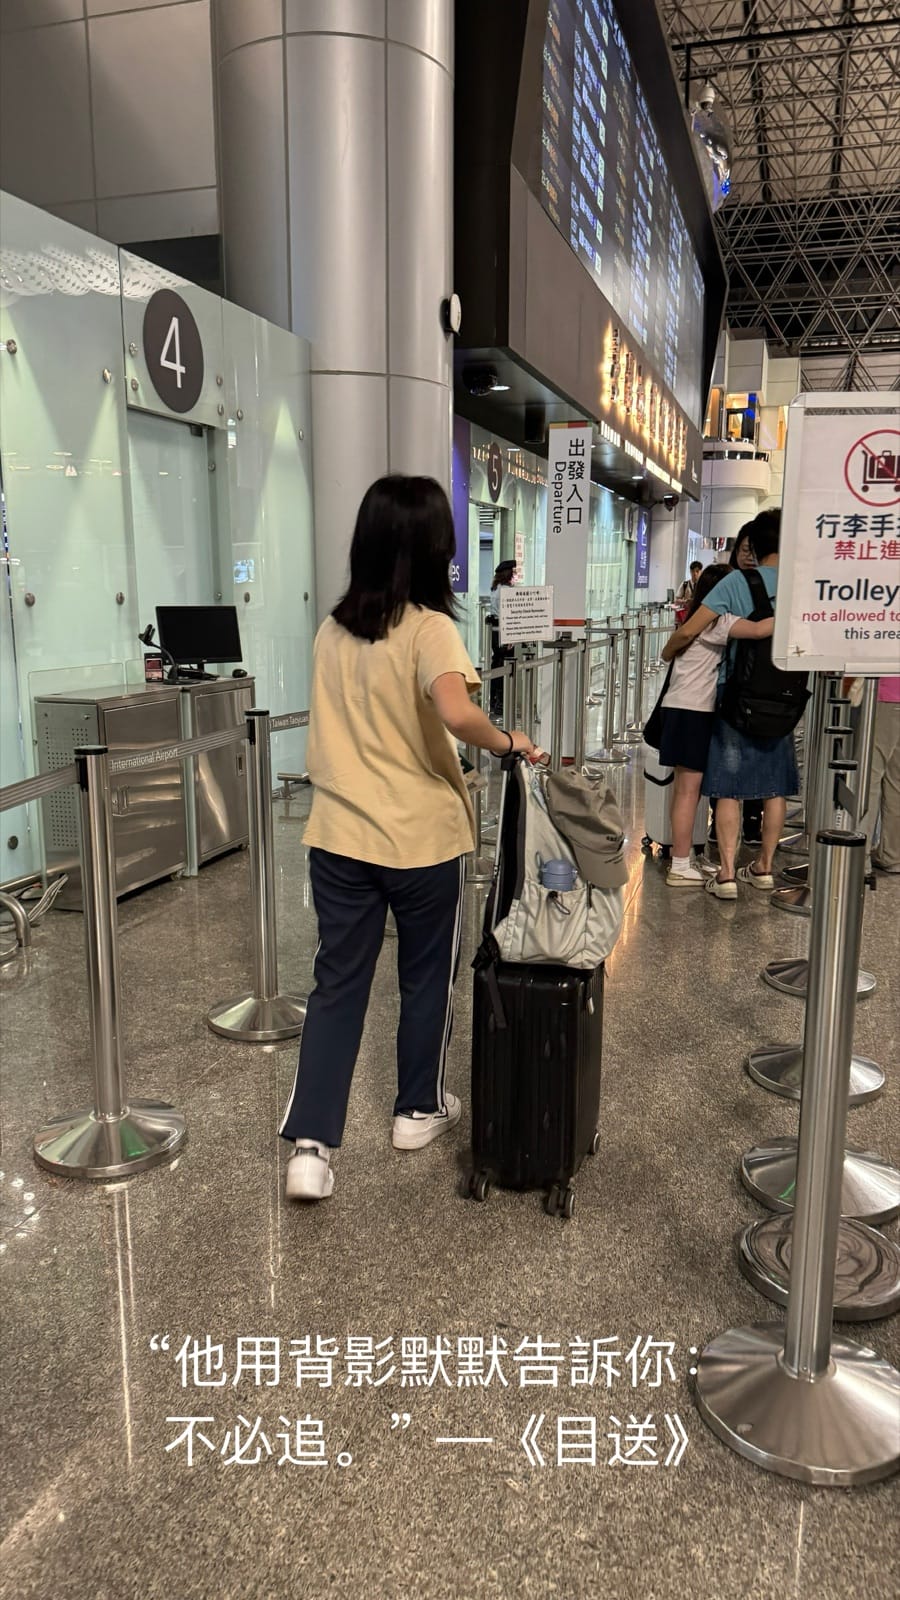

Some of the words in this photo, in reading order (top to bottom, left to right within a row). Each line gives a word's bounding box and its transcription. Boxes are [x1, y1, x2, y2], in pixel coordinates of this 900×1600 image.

[160, 316, 186, 389] 4
[492, 454, 499, 491] 5
[566, 438, 586, 525] 出發入口
[551, 461, 567, 534] Departure
[815, 513, 900, 539] 行李手
[834, 540, 900, 561] 禁止進
[802, 610, 826, 622] not
[830, 609, 886, 622] allowed
[890, 610, 900, 622] to
[844, 627, 870, 640] this
[873, 629, 900, 640] area
[111, 751, 155, 770] International
[155, 748, 178, 763] Airport
